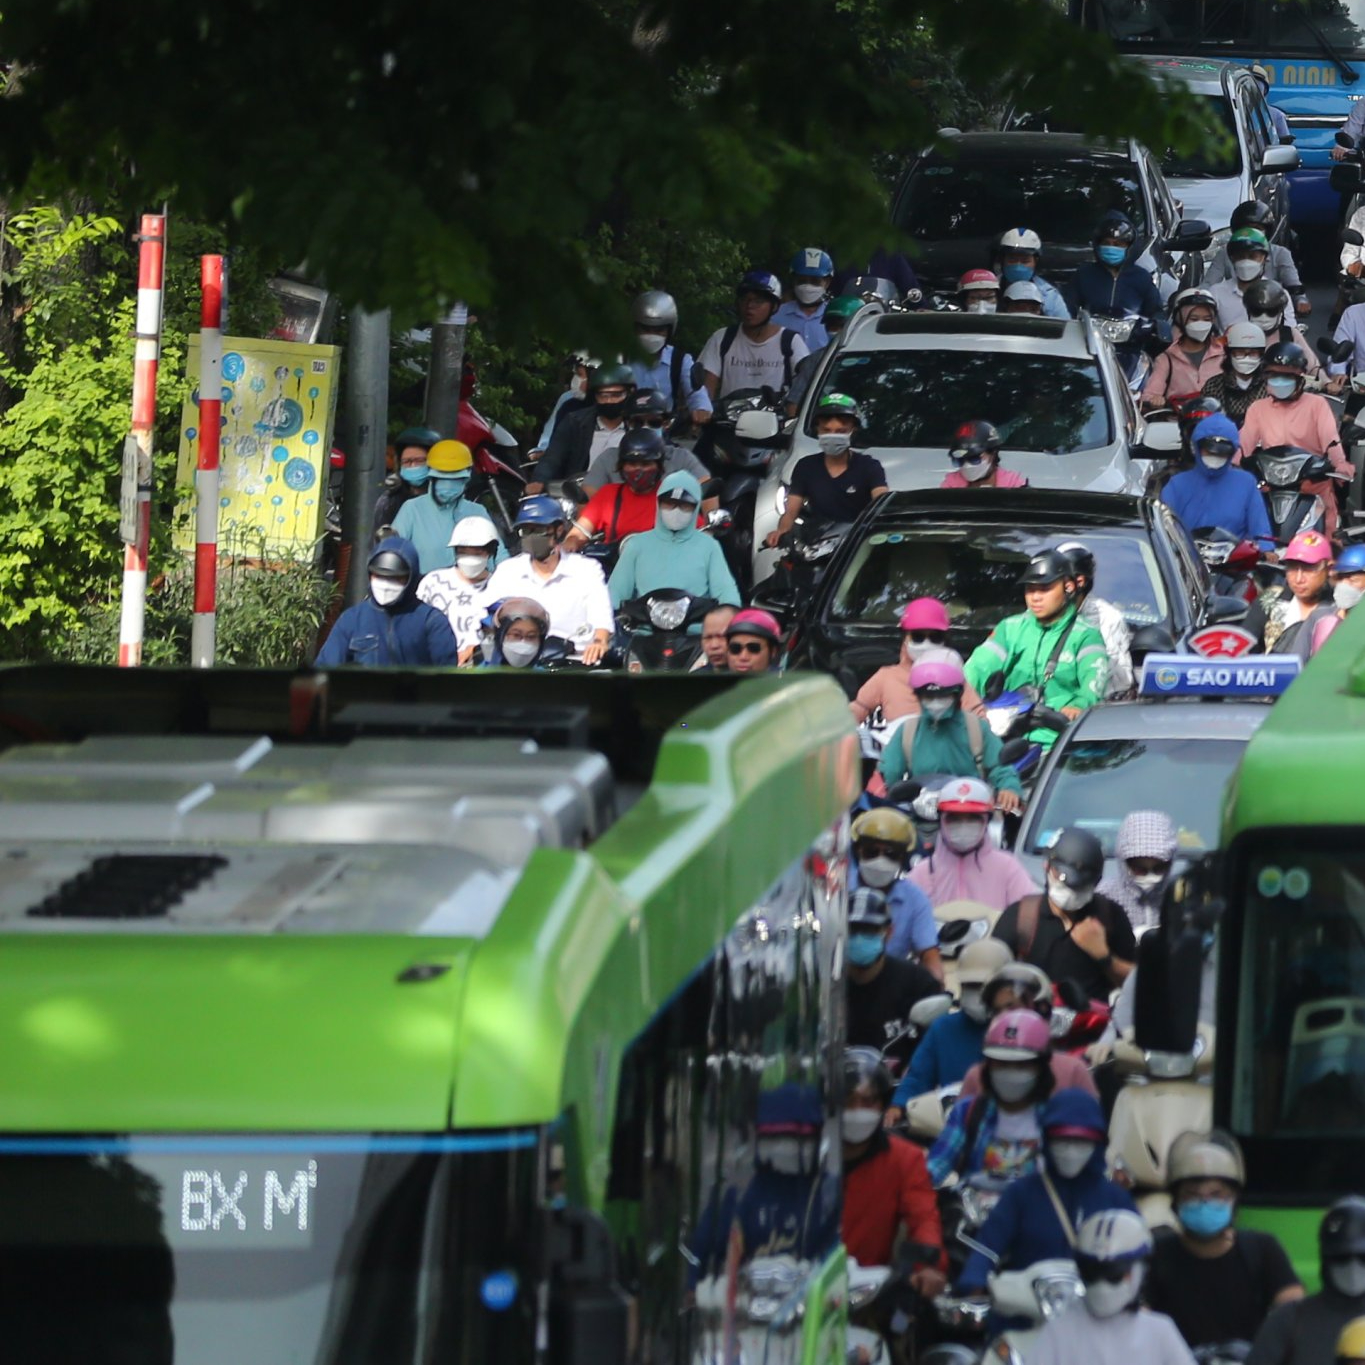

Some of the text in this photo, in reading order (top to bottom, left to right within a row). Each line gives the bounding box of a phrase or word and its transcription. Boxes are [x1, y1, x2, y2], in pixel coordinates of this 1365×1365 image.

[1186, 668, 1231, 687] SAO
[1236, 669, 1276, 687] MAI
[181, 1169, 249, 1231] BX
